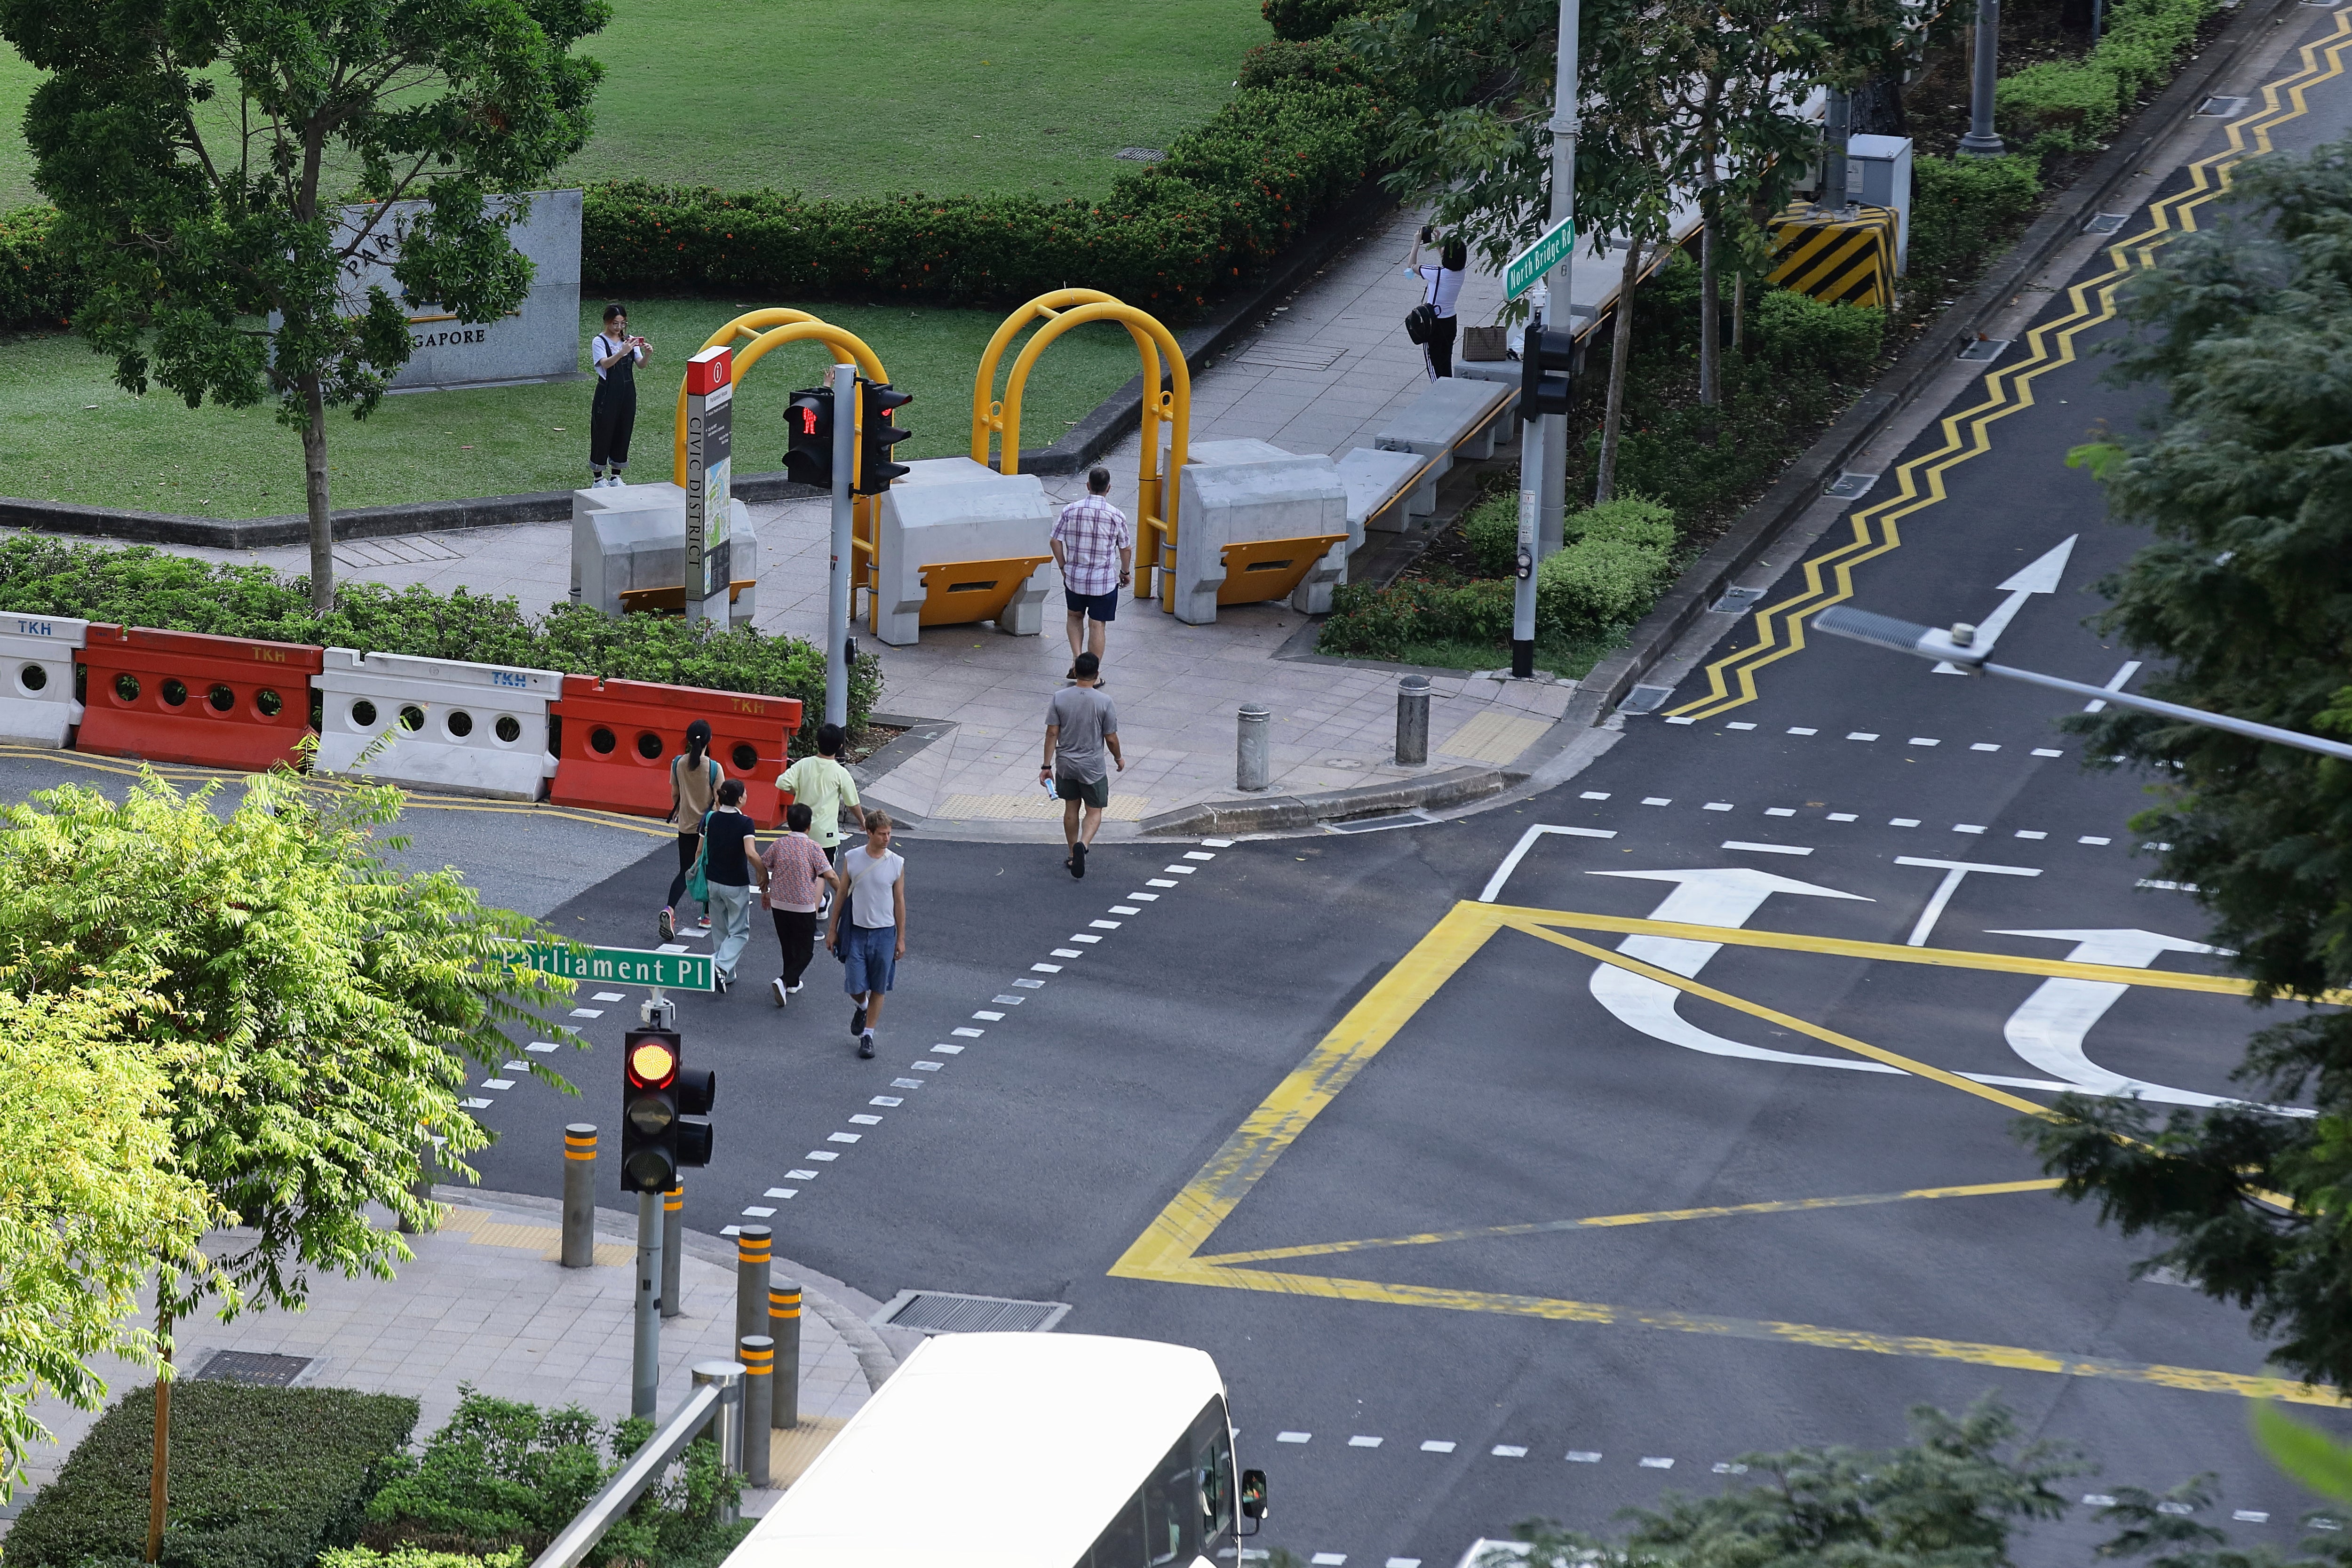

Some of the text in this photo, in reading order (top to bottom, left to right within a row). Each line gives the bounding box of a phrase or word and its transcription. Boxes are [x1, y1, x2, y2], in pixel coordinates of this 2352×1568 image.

[1510, 224, 1571, 290] North Bridge Rd
[413, 329, 485, 348] GAPORE
[689, 417, 701, 569] CIVIC DISTRICT
[18, 620, 51, 636] TKH
[252, 646, 285, 662] TKH
[492, 671, 526, 688] TKH
[731, 698, 764, 714] TKH
[678, 960, 703, 986] Pl
